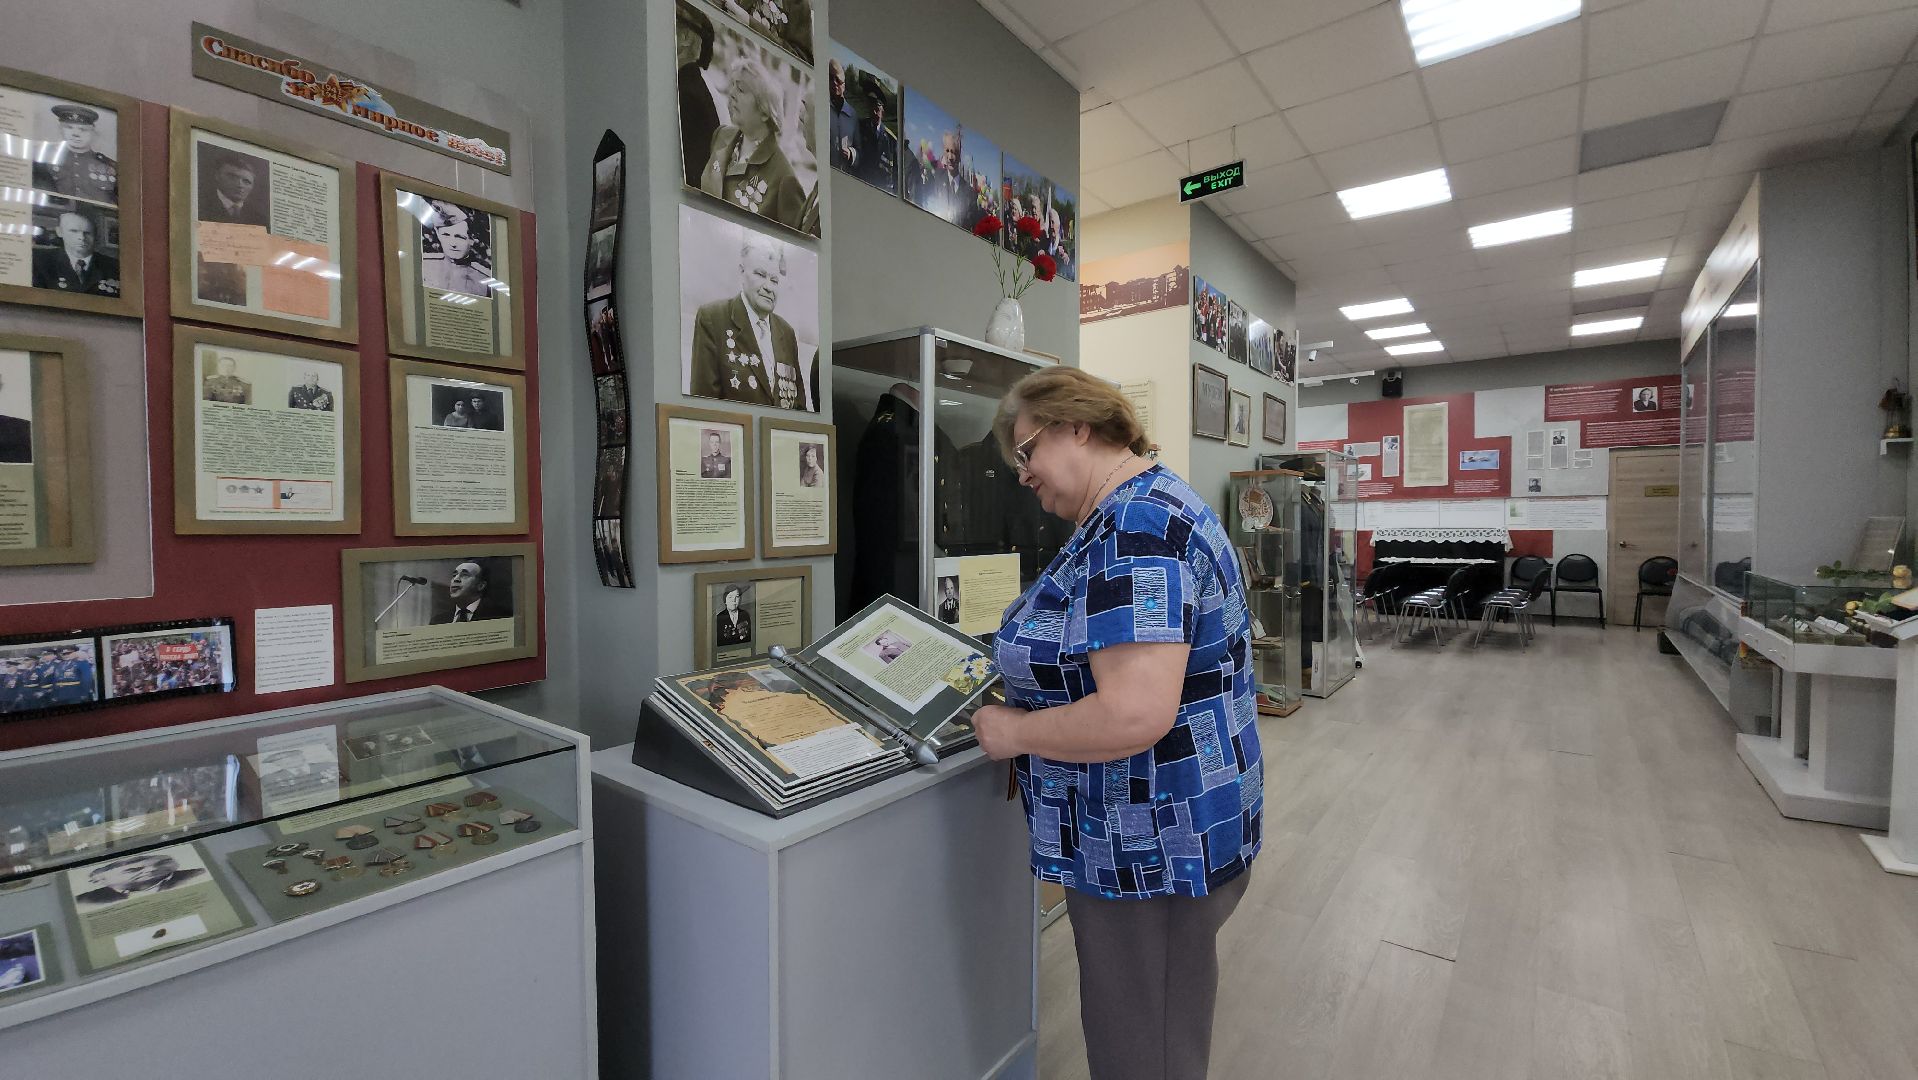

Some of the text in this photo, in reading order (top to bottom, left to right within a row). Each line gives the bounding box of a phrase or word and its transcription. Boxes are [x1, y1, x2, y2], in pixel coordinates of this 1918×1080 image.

[202, 36, 316, 84] Спасибо
[352, 104, 440, 143] мирное
[1203, 167, 1240, 183] ВЫХОД
[1211, 177, 1233, 190] EXIT
